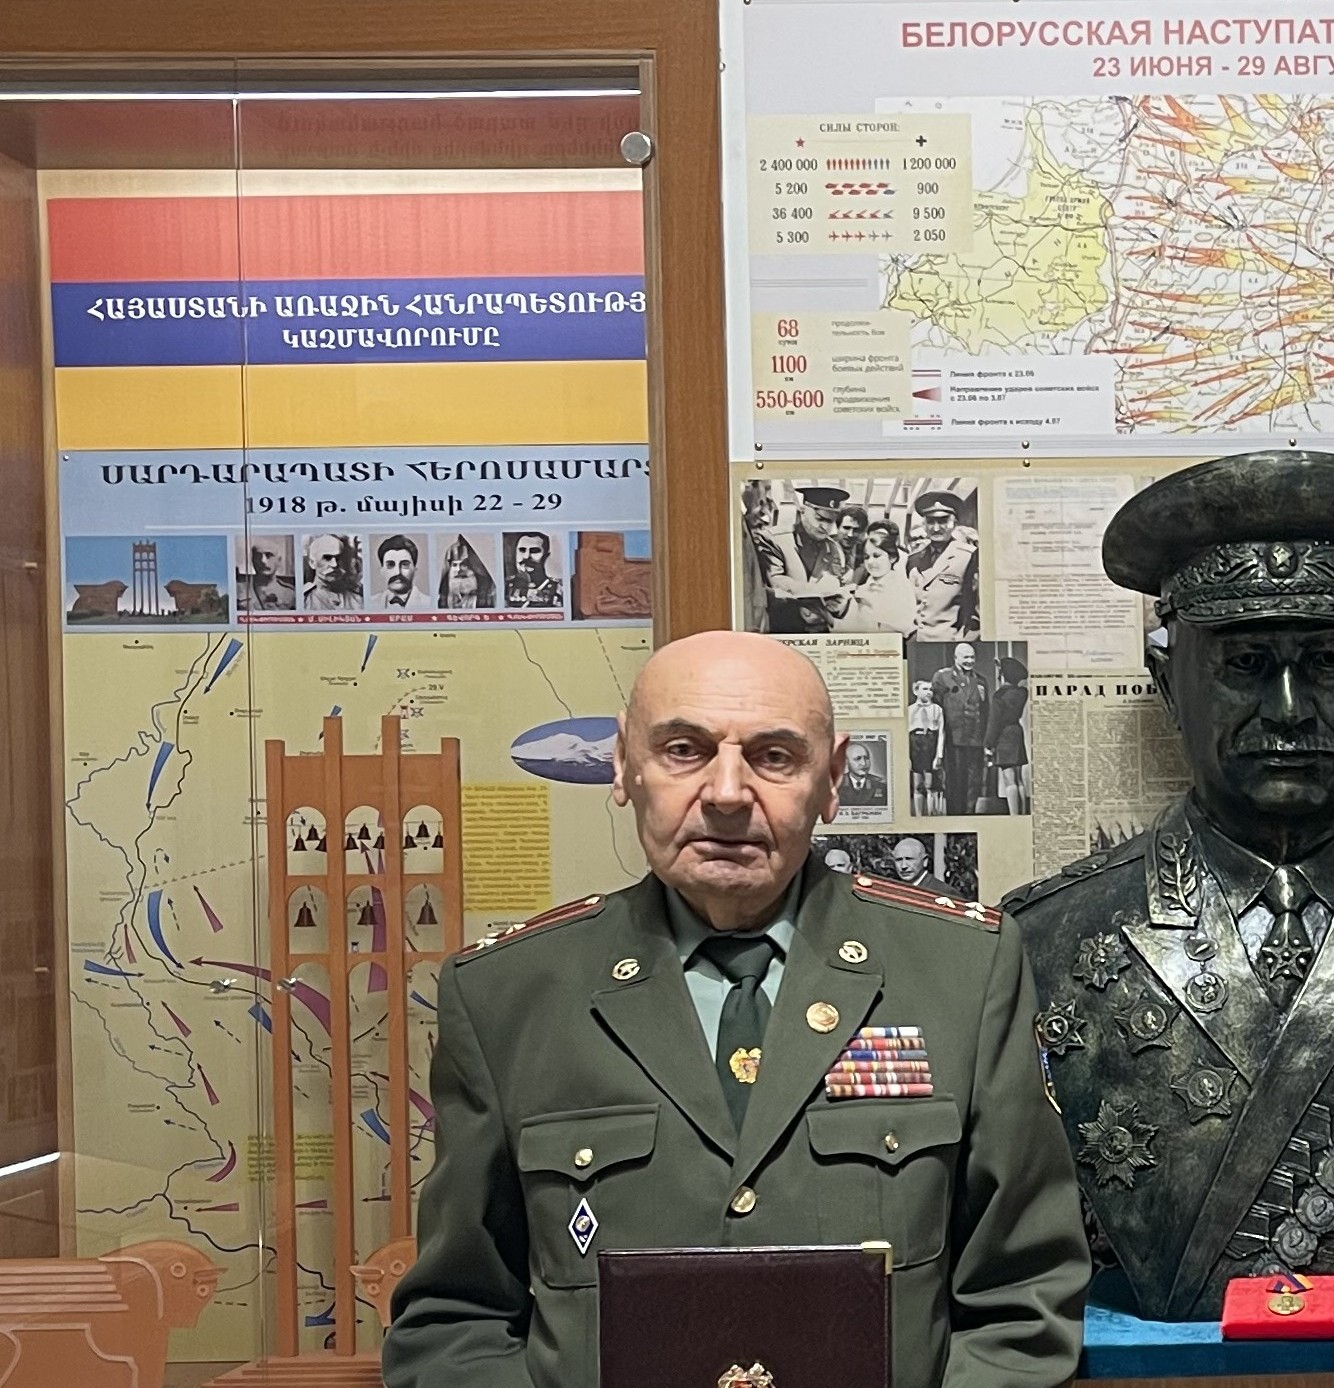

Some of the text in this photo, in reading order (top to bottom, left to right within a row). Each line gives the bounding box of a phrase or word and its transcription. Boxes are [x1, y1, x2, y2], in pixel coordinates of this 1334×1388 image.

[901, 20, 1151, 47] БЕЛОРУССКАЯ
[1092, 56, 1121, 77] 23
[1130, 56, 1213, 76] ИЮНЯ
[1237, 55, 1265, 76] 29
[819, 123, 851, 132] СИЛЫ
[771, 159, 792, 171] 400
[796, 158, 818, 170] 000
[935, 157, 956, 169] 000
[787, 183, 808, 194] 200
[917, 183, 939, 194] 900
[772, 208, 812, 219] 36 400
[924, 207, 945, 219] 500
[787, 231, 809, 243] 300
[924, 229, 946, 241] 050
[87, 295, 267, 321] ՀԱՅԱՍՏԱՆԻ
[274, 293, 399, 318] ԱՌԱՋԻՆ
[777, 319, 799, 337] 68
[282, 326, 501, 349] ԿԱԶՄԱՎՈՐՈՒՄԸ
[772, 355, 807, 373] 1100
[756, 390, 824, 408] 550-600
[101, 460, 394, 485] ՍԱՐԴԱՐԱՊԱՏԻ
[246, 496, 306, 514] 1918
[357, 495, 463, 517] մայիսի
[473, 494, 503, 511] 22
[531, 492, 562, 511] 29
[1036, 685, 1106, 698] ПАРАД
